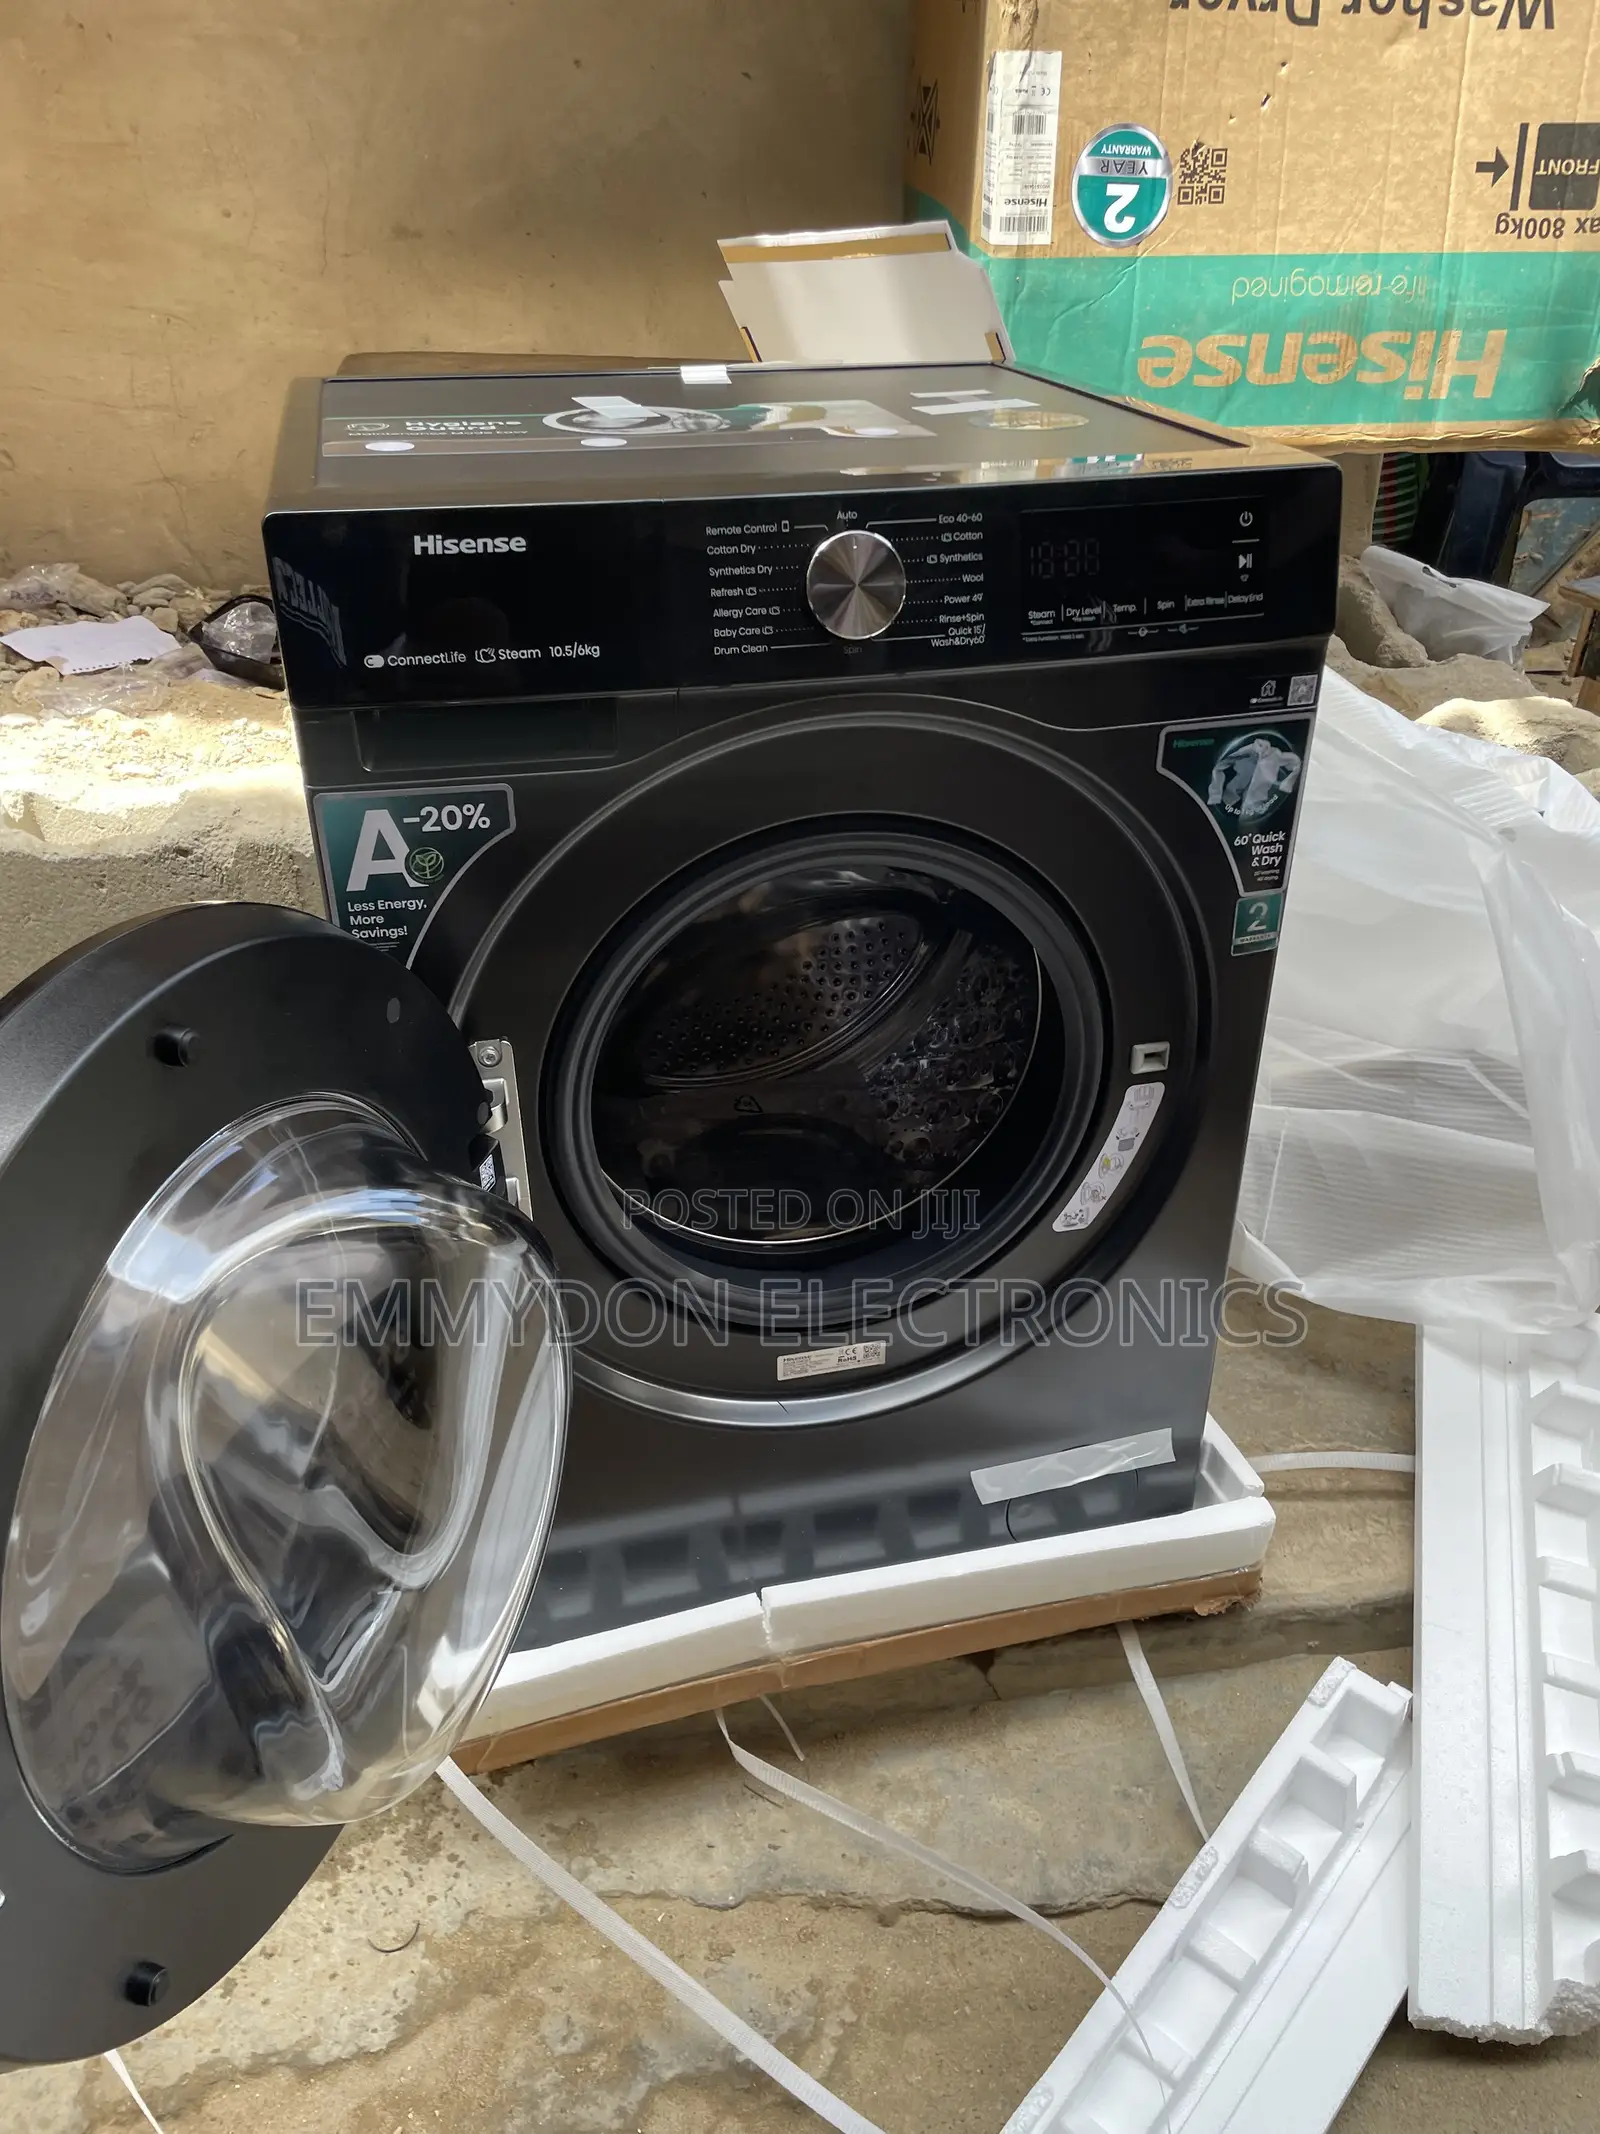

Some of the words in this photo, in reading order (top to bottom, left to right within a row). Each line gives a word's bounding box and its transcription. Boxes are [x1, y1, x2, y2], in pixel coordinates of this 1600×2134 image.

[1101, 143, 1152, 156] WARRANTY
[1100, 159, 1149, 175] YEAR
[1535, 159, 1600, 176] FRONT
[1003, 197, 1048, 208] Hisense
[1103, 183, 1140, 234] 2
[1494, 212, 1566, 240] 800kg
[1231, 268, 1381, 306] reimagined
[1137, 329, 1507, 401] Hisense
[836, 510, 858, 520] Auto
[938, 514, 955, 524] Eco
[956, 512, 983, 523] 40-60
[706, 525, 742, 536] Remote
[743, 523, 778, 534] Control
[953, 531, 984, 541] Cotton
[414, 534, 527, 556] Hisense
[707, 545, 739, 555] Cotton
[740, 543, 756, 554] Dry
[939, 552, 984, 565] Synthetics
[708, 565, 756, 578] Synthetics
[757, 564, 773, 575] Dry
[962, 572, 984, 583] Wool
[710, 587, 744, 598] Refresh
[944, 595, 970, 604] Power
[713, 608, 744, 619] Allergy
[745, 606, 768, 616] Care
[1028, 610, 1056, 620] Steam
[1066, 607, 1080, 618] Dry
[1081, 605, 1102, 615] Level
[1157, 600, 1175, 611] Spin
[939, 612, 985, 624] Rinse+Spin
[713, 628, 737, 638] Baby
[738, 626, 761, 636] Care
[948, 626, 972, 636] Quick
[387, 651, 467, 667] ConnectLife
[498, 648, 542, 660] Steam
[549, 642, 601, 660] 10.5/6kg
[714, 646, 740, 655] Drum
[741, 644, 768, 654] Clean
[843, 644, 863, 656] Spin
[1252, 830, 1286, 844] Quick
[1251, 842, 1283, 856] Wash
[1251, 856, 1259, 867] &
[1261, 855, 1282, 867] Dry
[347, 900, 376, 913] Less
[379, 898, 427, 912] Energy,
[349, 914, 385, 926] More
[1246, 901, 1269, 932] 2
[352, 925, 408, 939] Savings!
